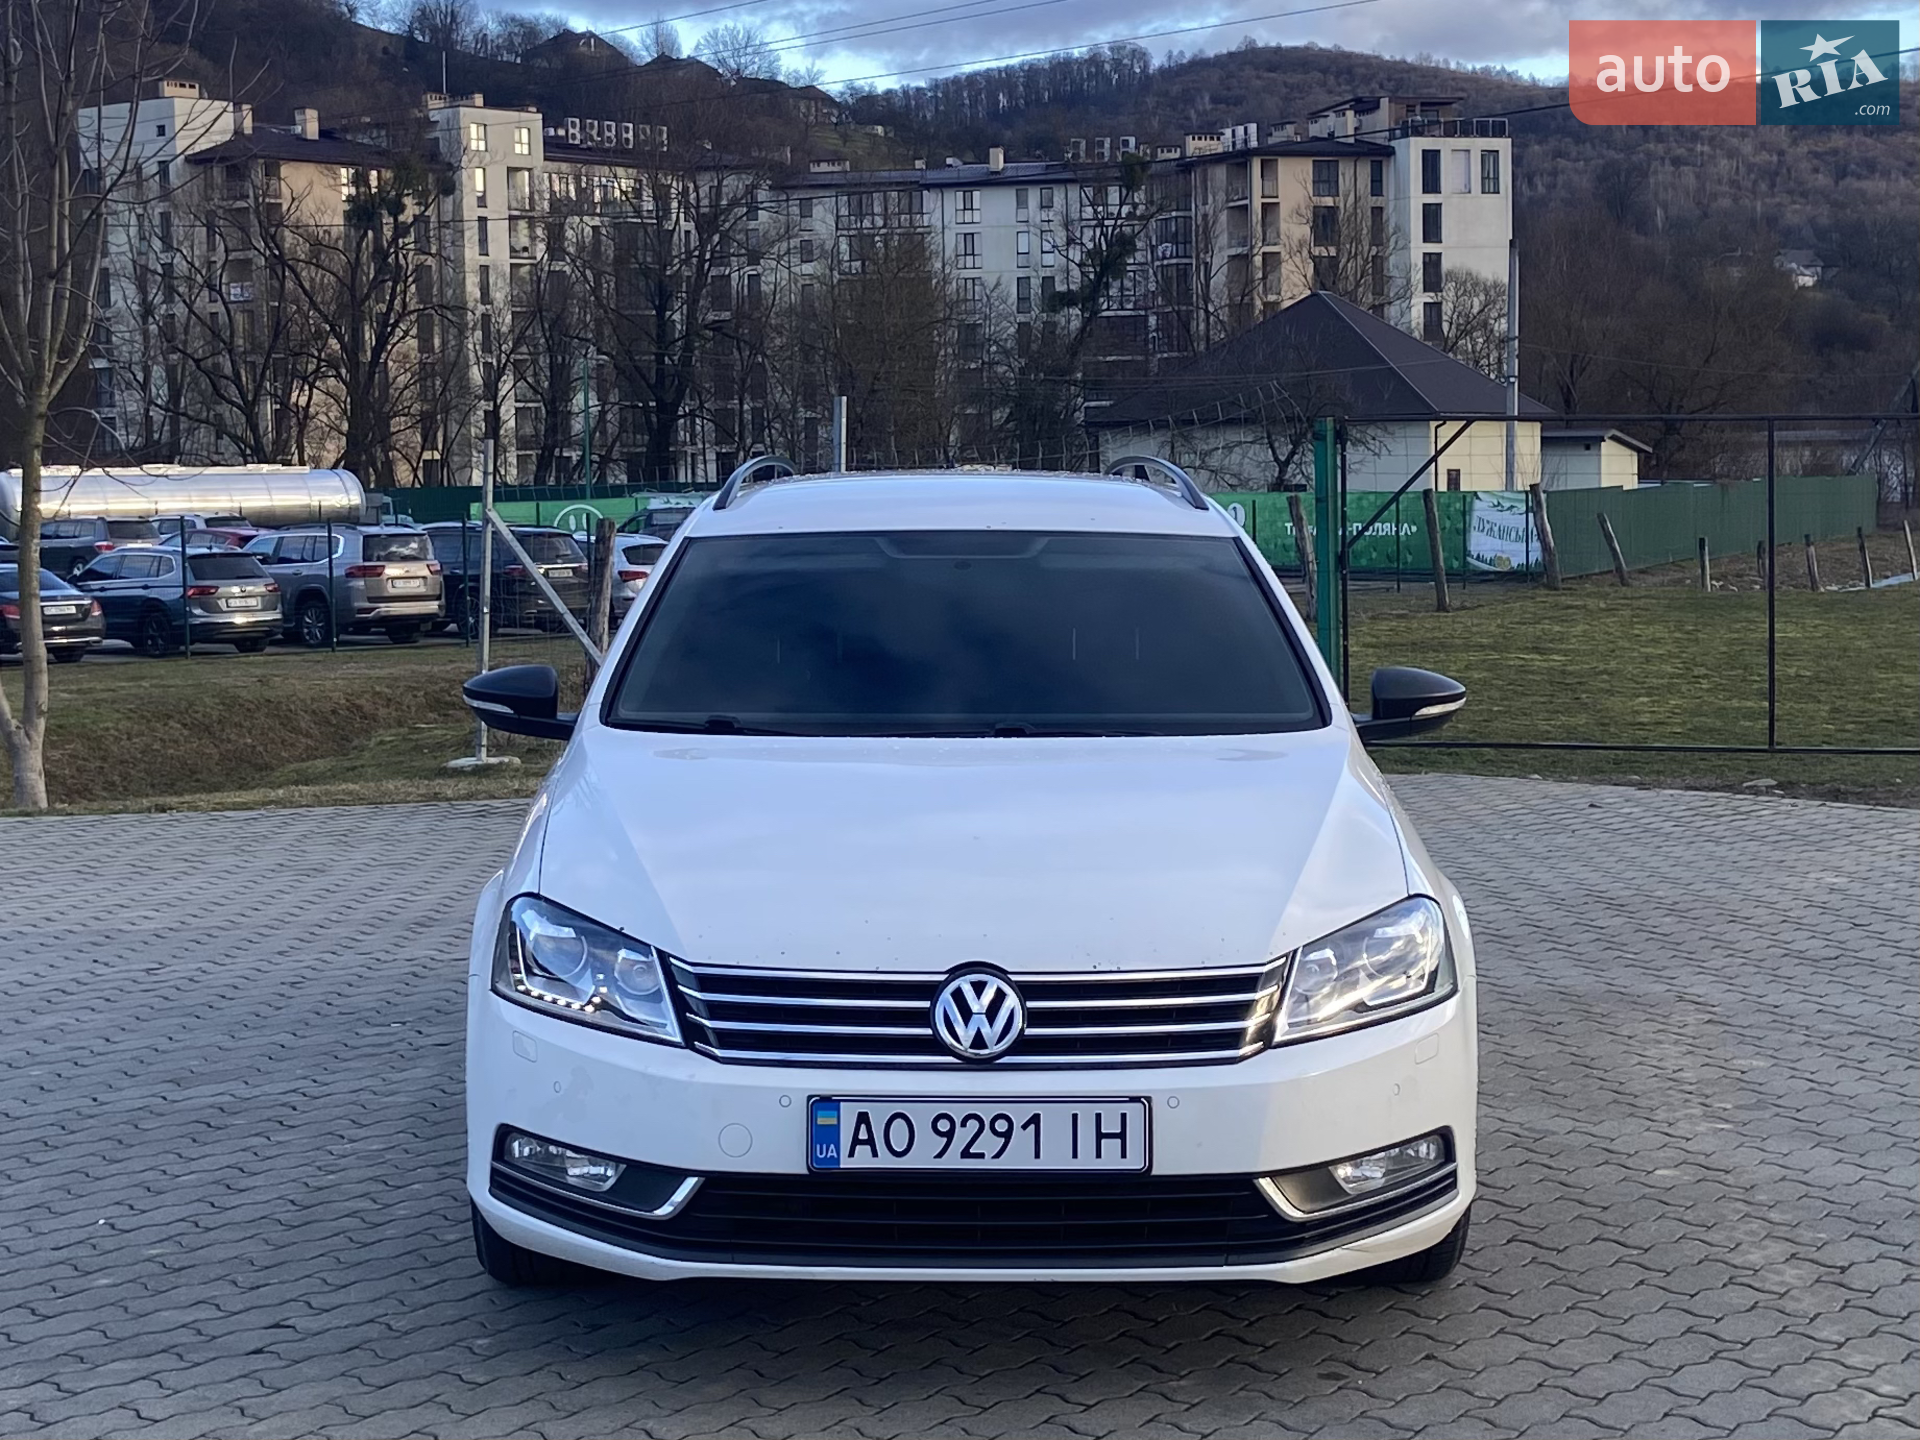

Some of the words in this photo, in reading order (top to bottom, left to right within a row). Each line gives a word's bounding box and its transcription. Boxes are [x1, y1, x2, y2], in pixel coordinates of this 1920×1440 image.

[938, 976, 1020, 1052] VW
[816, 1143, 838, 1159] UA
[847, 1111, 915, 1159] AO
[931, 1112, 1041, 1160] 9291
[1071, 1112, 1128, 1160] IH
